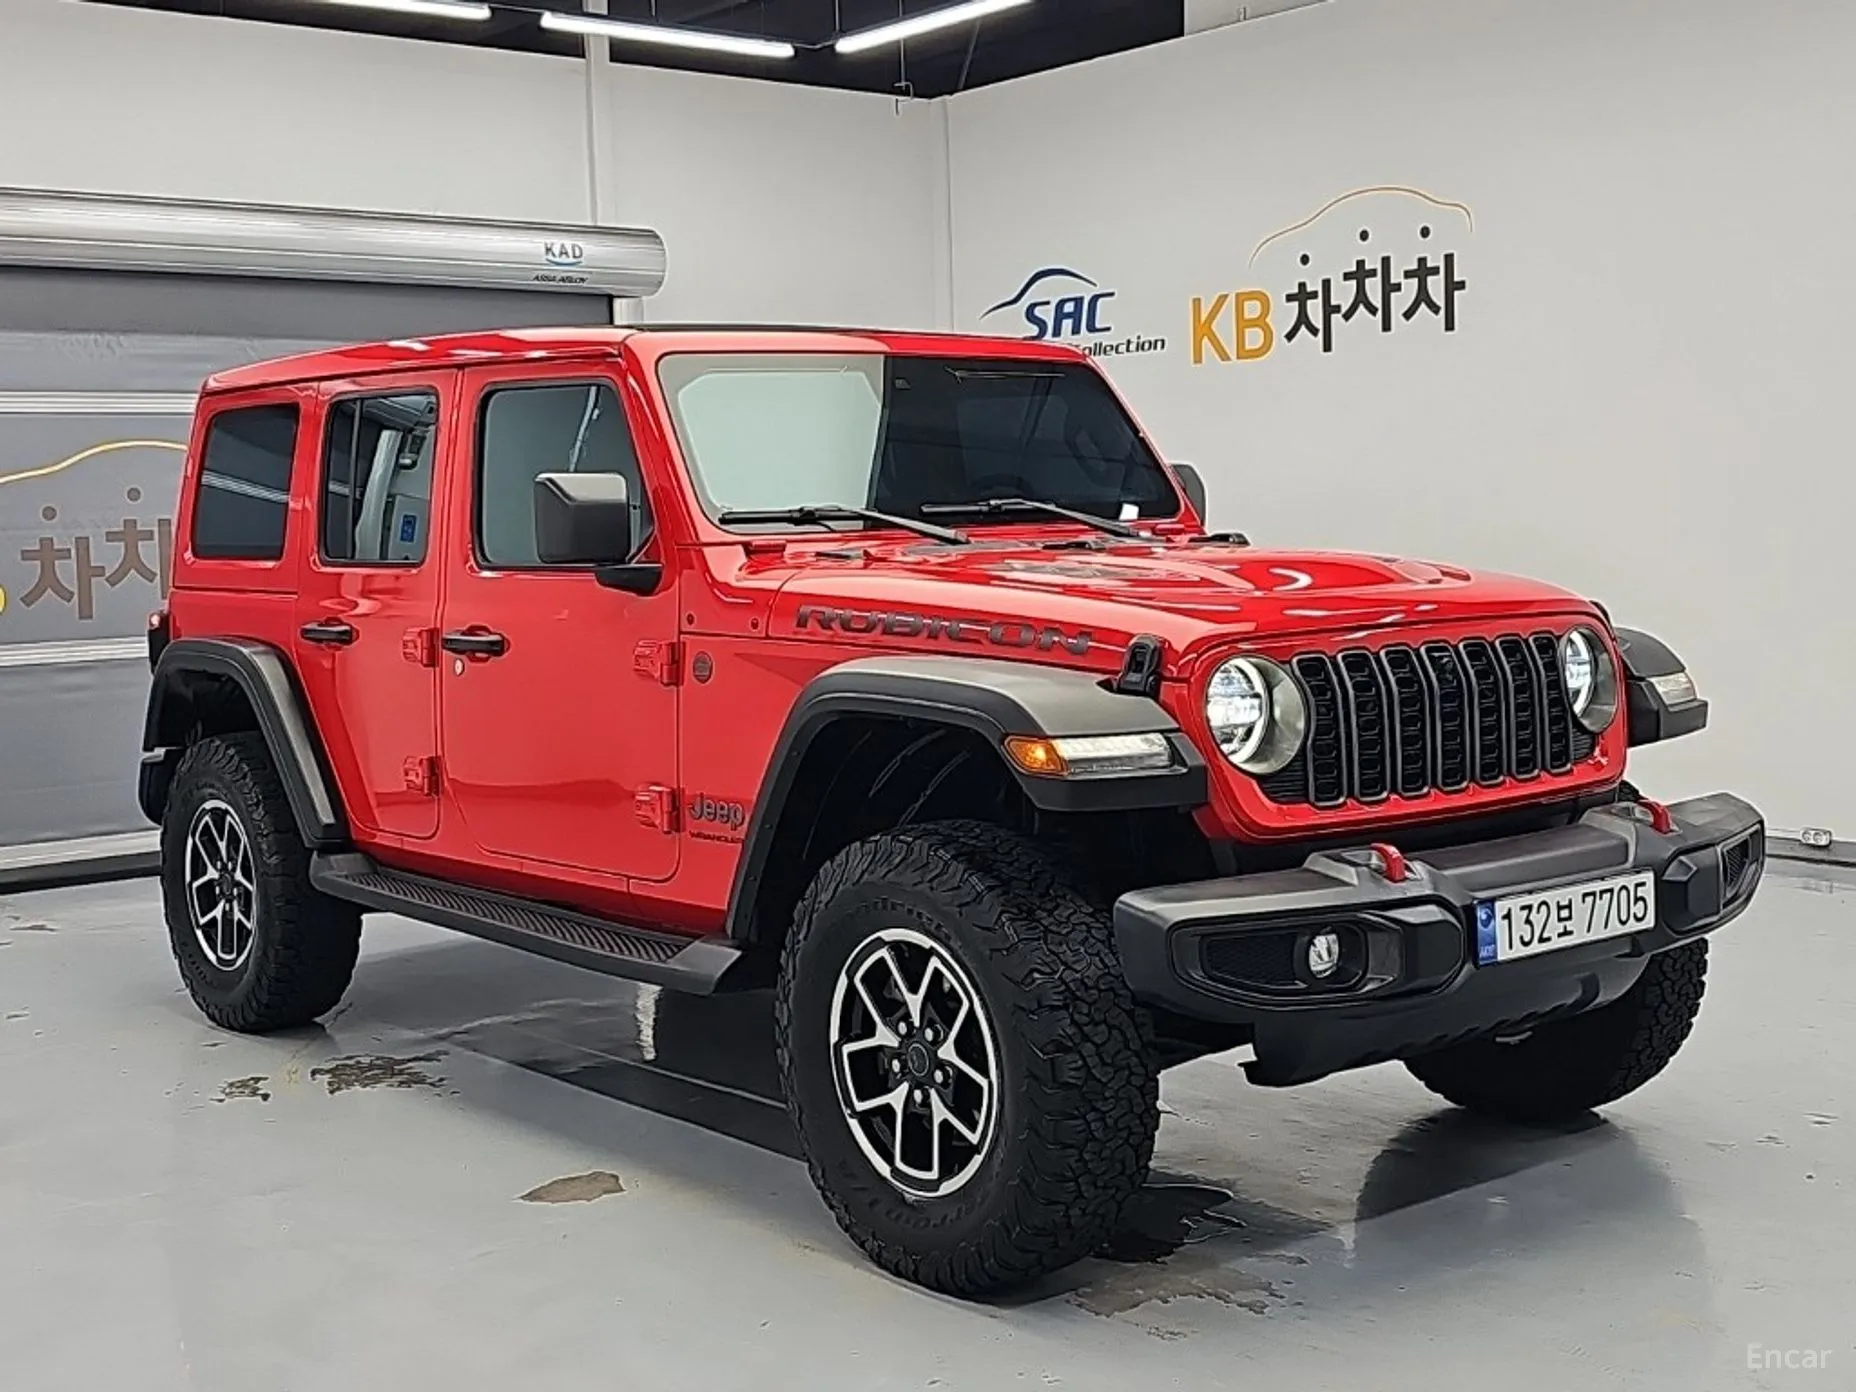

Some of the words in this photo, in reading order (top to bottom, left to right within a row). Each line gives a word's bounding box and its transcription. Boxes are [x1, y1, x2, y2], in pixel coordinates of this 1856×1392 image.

[544, 242, 583, 259] KAD
[1024, 292, 1116, 340] SAC
[1191, 290, 1274, 364] KB
[1284, 225, 1466, 352] 차차차
[1073, 335, 1165, 357] ollection
[795, 604, 1093, 656] RUBICON
[688, 792, 746, 831] Jeep
[1501, 898, 1574, 950] 132보
[1582, 881, 1648, 934] 7705
